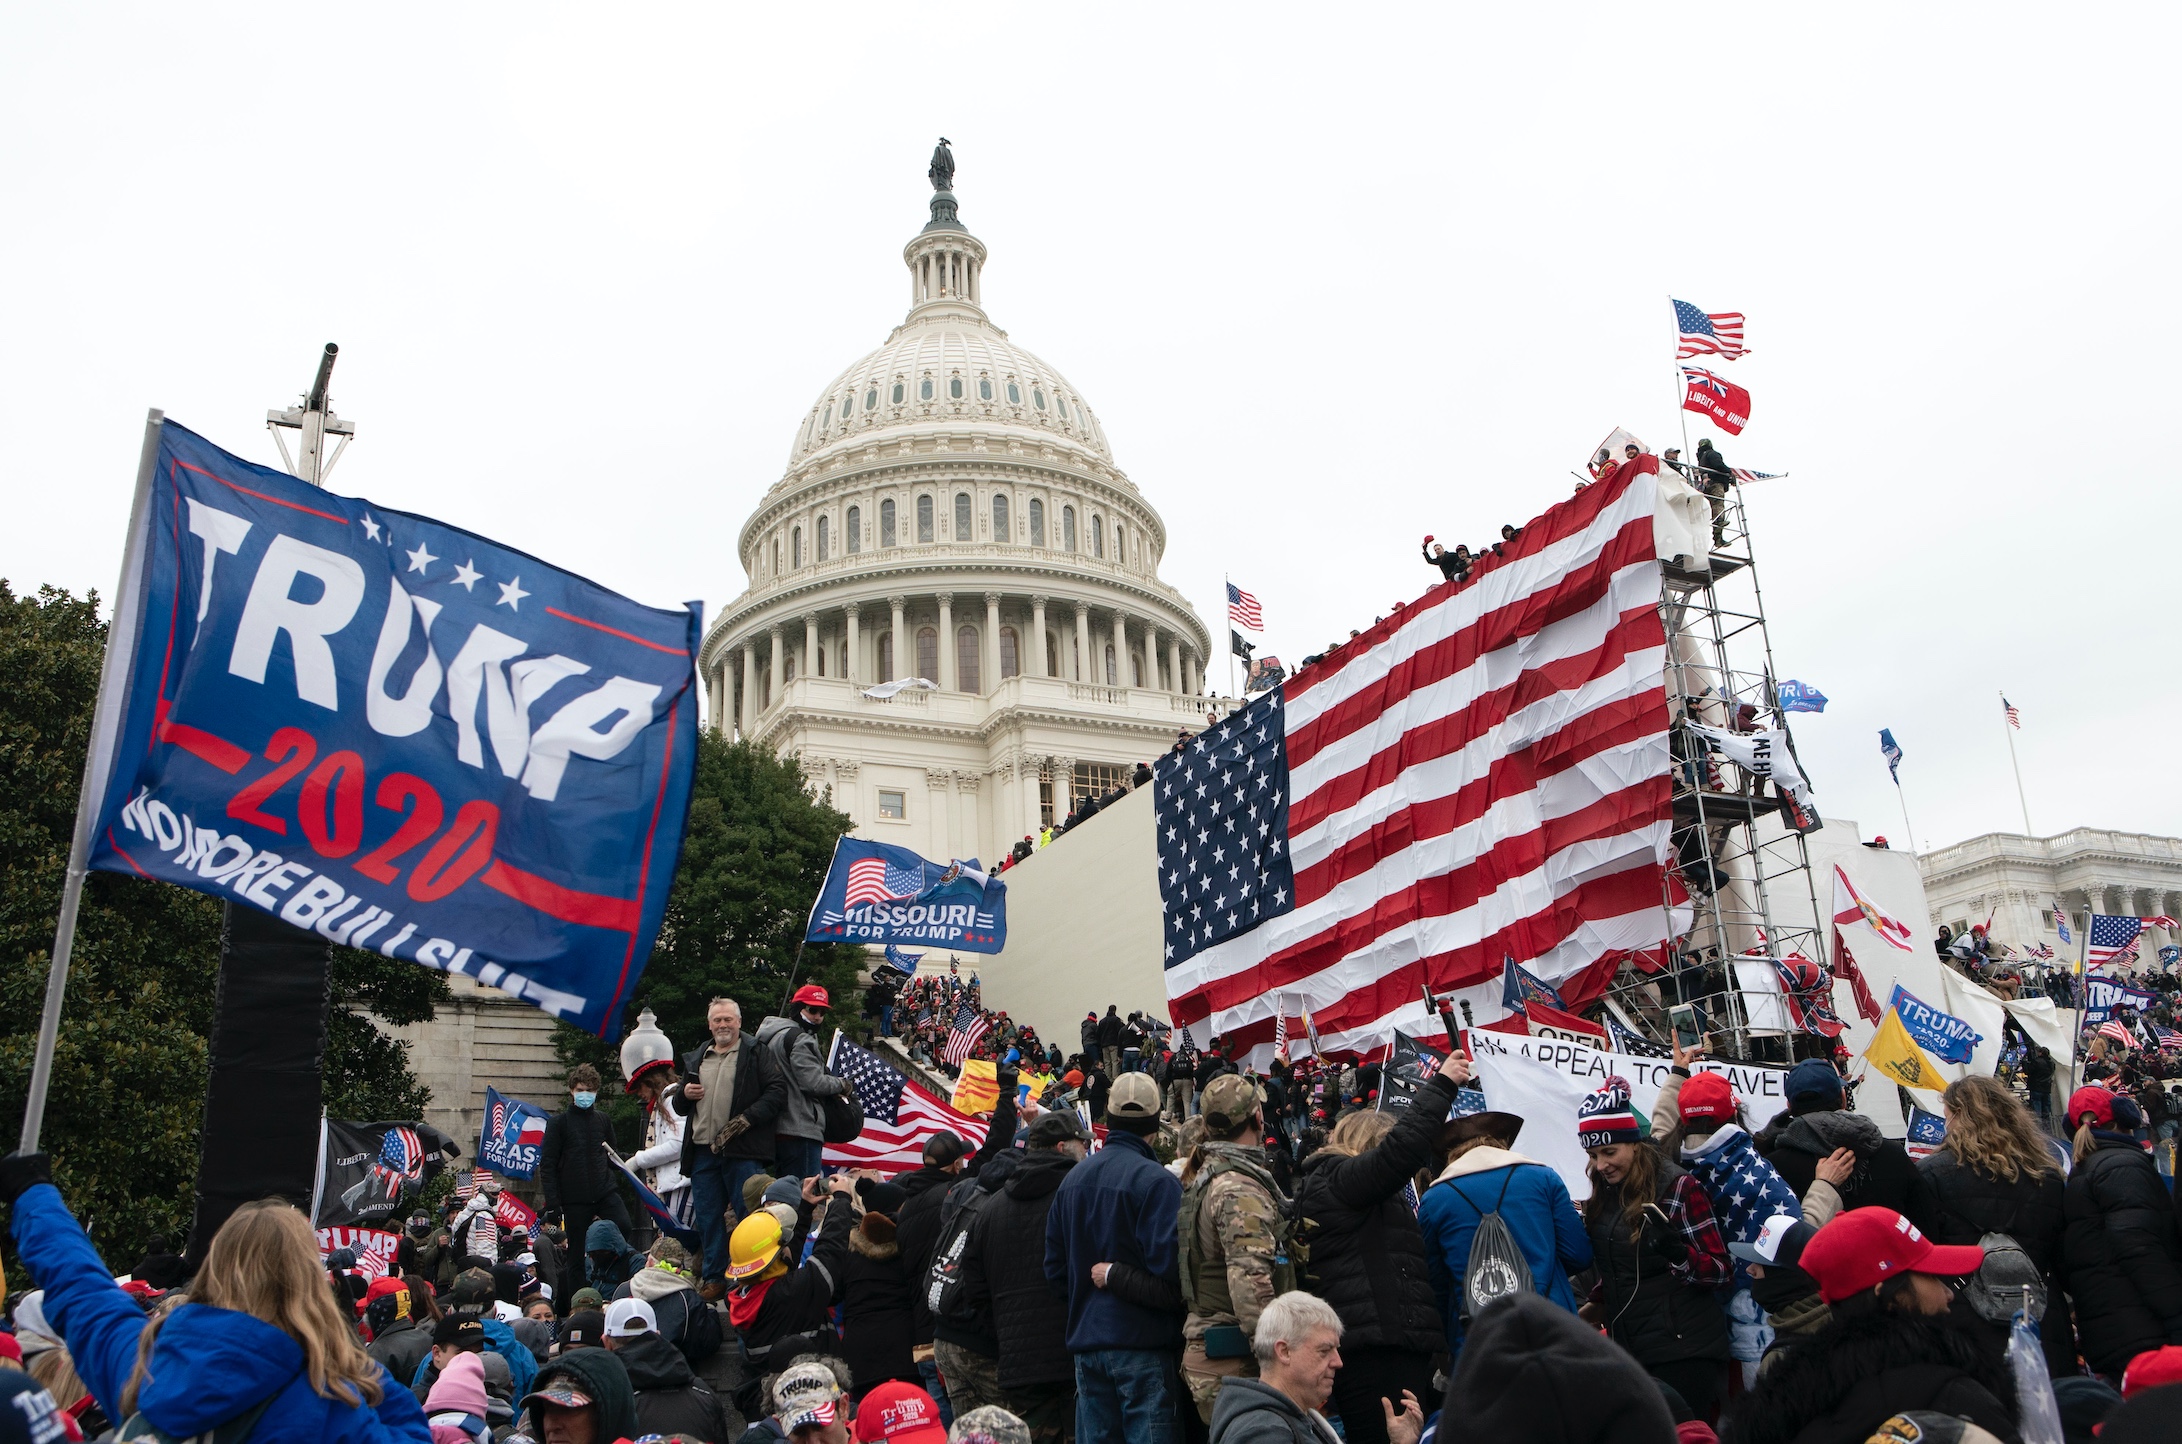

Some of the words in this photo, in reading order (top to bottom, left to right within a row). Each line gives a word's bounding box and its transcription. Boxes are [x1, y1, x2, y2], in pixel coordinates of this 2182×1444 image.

[1688, 391, 1715, 409] LIBERTY
[1713, 405, 1726, 417] AND
[1727, 412, 1748, 428] UNIO
[185, 497, 662, 801] TRUMP
[227, 726, 500, 902] 2020
[1800, 809, 1815, 826] FOR
[122, 785, 182, 851] NO
[173, 813, 313, 911] MORE
[845, 901, 976, 927] MISSOURI
[845, 924, 885, 938] FOR
[891, 926, 962, 940] TRUMP
[1903, 998, 1976, 1042] TRUMP
[1471, 1034, 1507, 1056] AN
[1633, 1062, 1670, 1088] TO
[1579, 1089, 1629, 1115] RUMP
[1580, 1131, 1612, 1149] 020
[336, 1152, 371, 1166] LIBERTY
[486, 1152, 502, 1164] FOR
[502, 1157, 533, 1172] UMP
[499, 1199, 527, 1223] MP
[315, 1227, 397, 1260] RUMP
[779, 1378, 823, 1399] TRUMP
[881, 1403, 925, 1420] Trump
